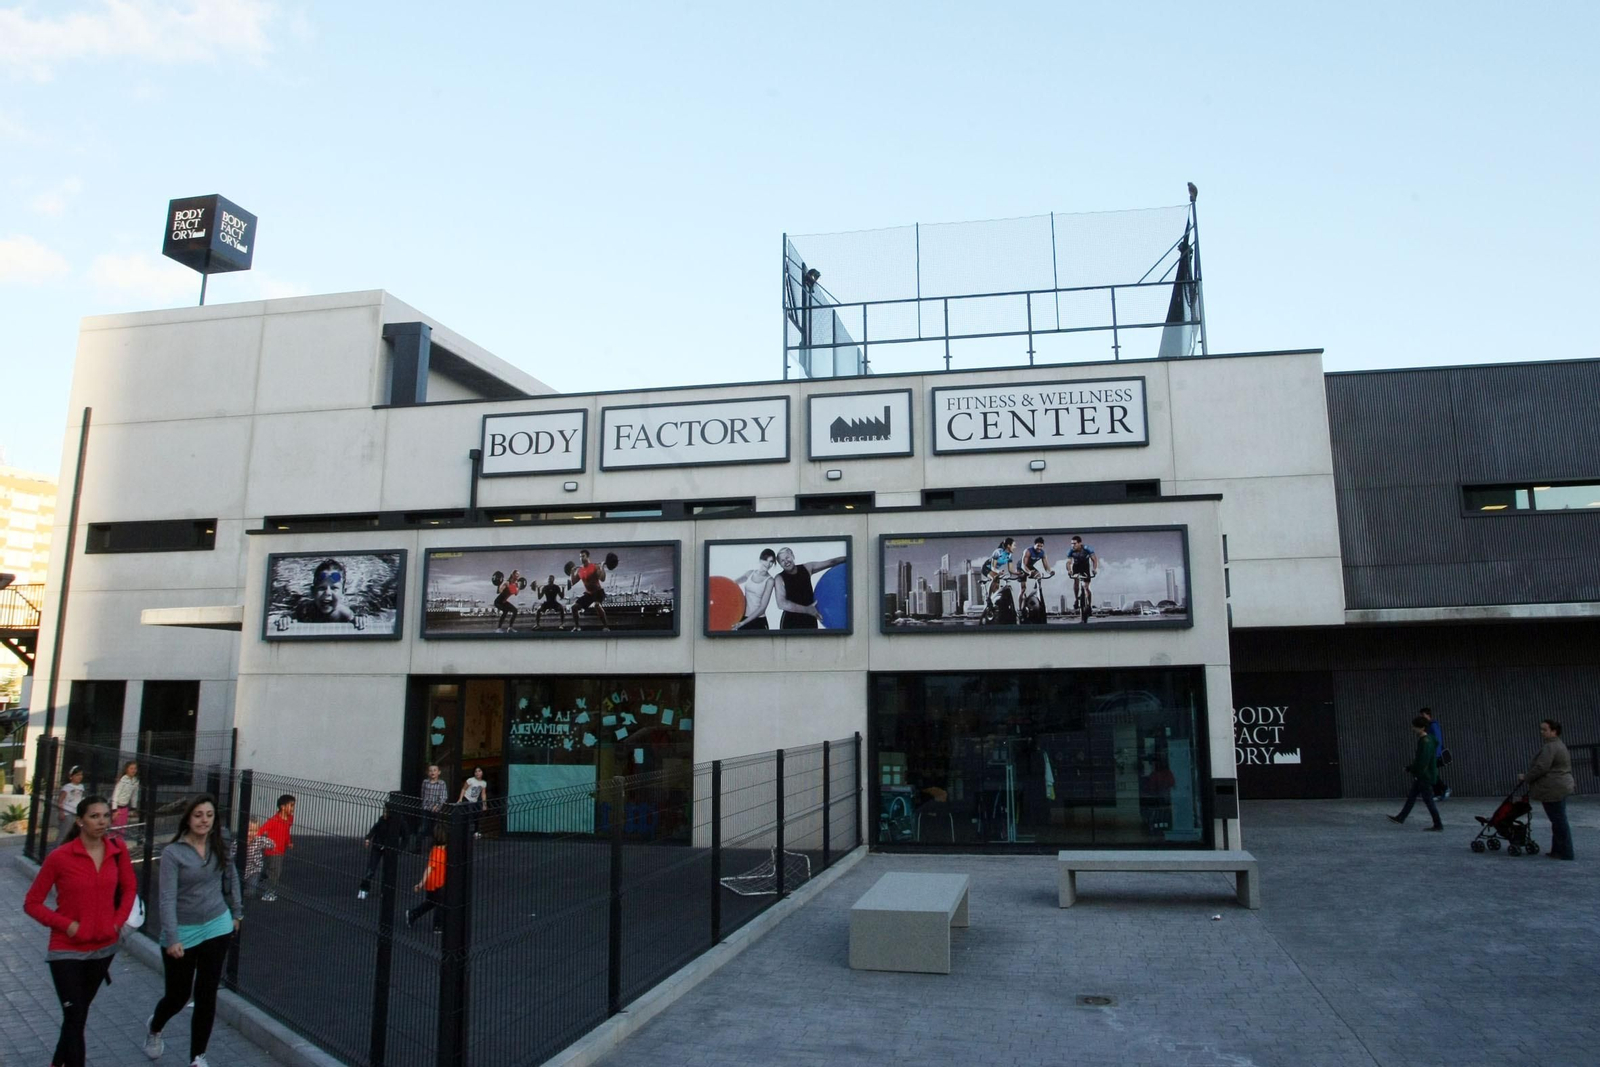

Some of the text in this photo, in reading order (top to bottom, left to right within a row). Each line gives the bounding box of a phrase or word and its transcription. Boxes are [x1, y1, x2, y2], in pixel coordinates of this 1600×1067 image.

[175, 208, 205, 220] BODY
[222, 211, 247, 231] BODY
[173, 219, 200, 230] FACT
[221, 221, 244, 239] FACT
[172, 229, 194, 240] ORY
[220, 232, 239, 248] ORY
[946, 388, 1134, 411] FITNESS & WELLNESS
[947, 405, 1134, 442] CENTER
[613, 416, 776, 451] FACTORY
[830, 434, 892, 444] ALGECIRAS
[488, 428, 579, 458] BODY
